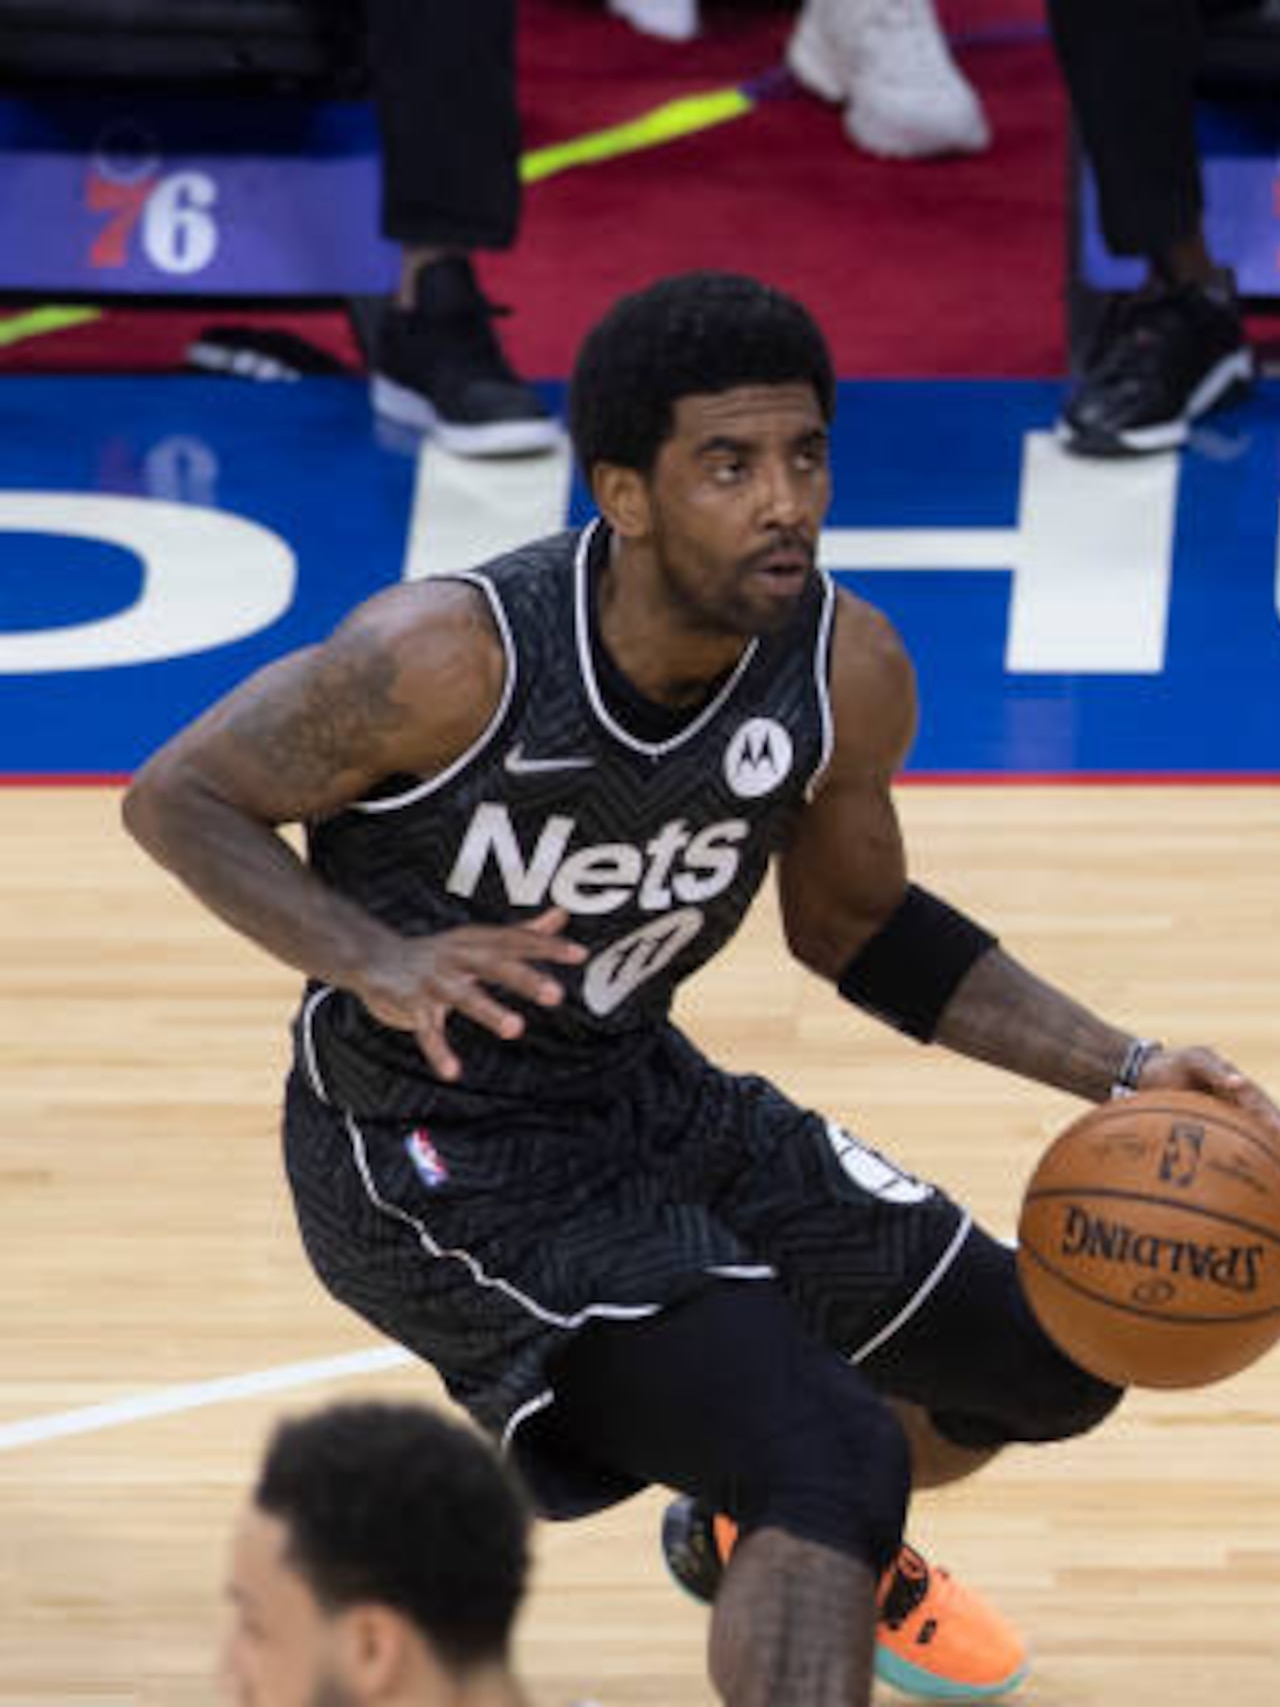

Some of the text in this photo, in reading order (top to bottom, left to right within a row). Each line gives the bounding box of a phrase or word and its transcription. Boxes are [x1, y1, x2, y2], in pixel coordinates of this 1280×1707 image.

[86, 170, 219, 274] 76
[446, 801, 750, 915] Nets
[1061, 1204, 1264, 1293] SPALDING
